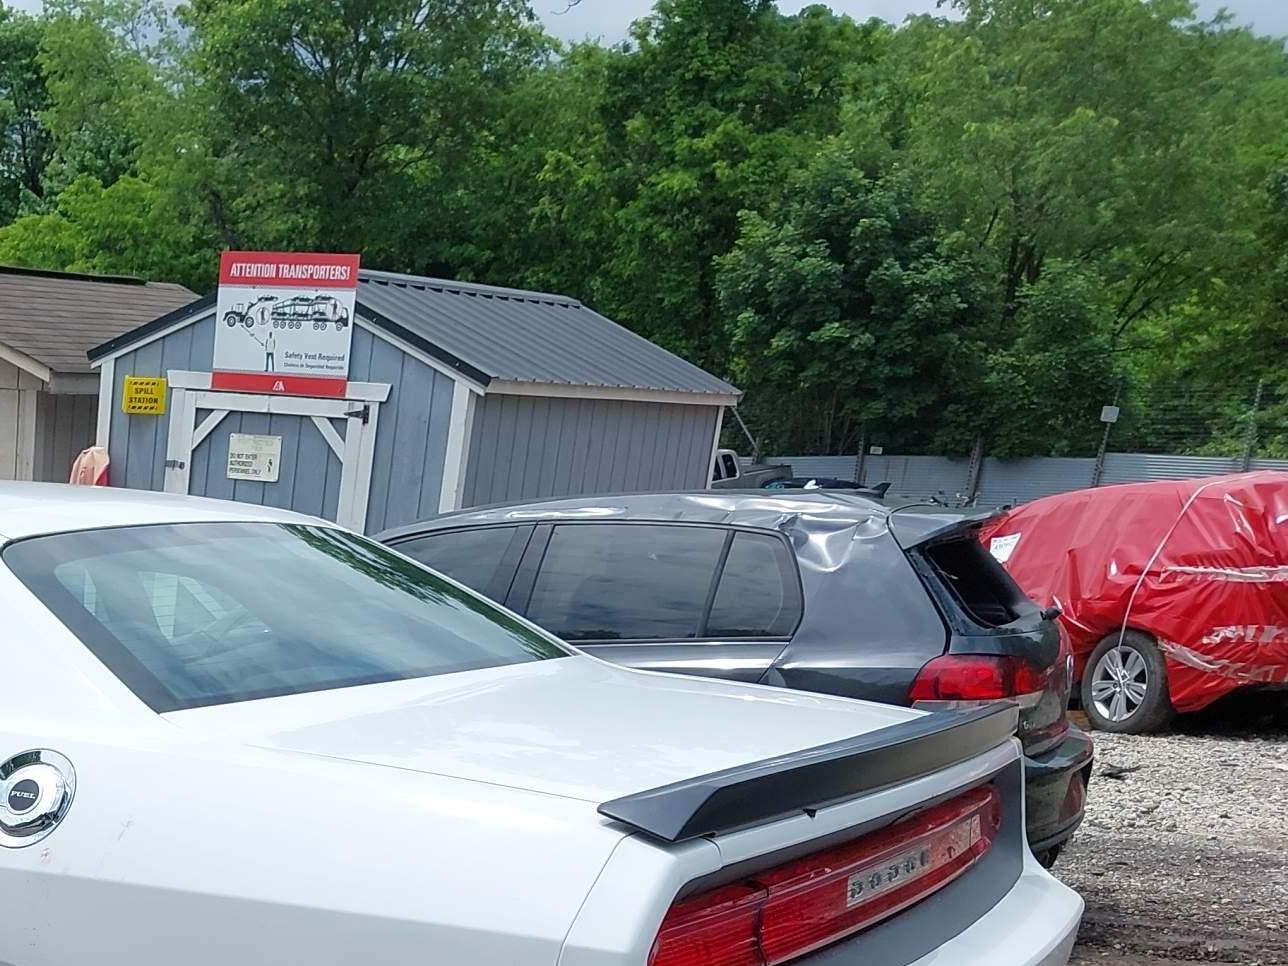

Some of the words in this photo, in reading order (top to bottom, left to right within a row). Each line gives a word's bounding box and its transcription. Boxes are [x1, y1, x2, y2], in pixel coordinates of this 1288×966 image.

[230, 263, 276, 278] ATTENTION
[278, 264, 351, 281] TRANSPORTERS!
[284, 351, 303, 361] Safety
[304, 352, 317, 360] Vest
[128, 396, 159, 404] STATION
